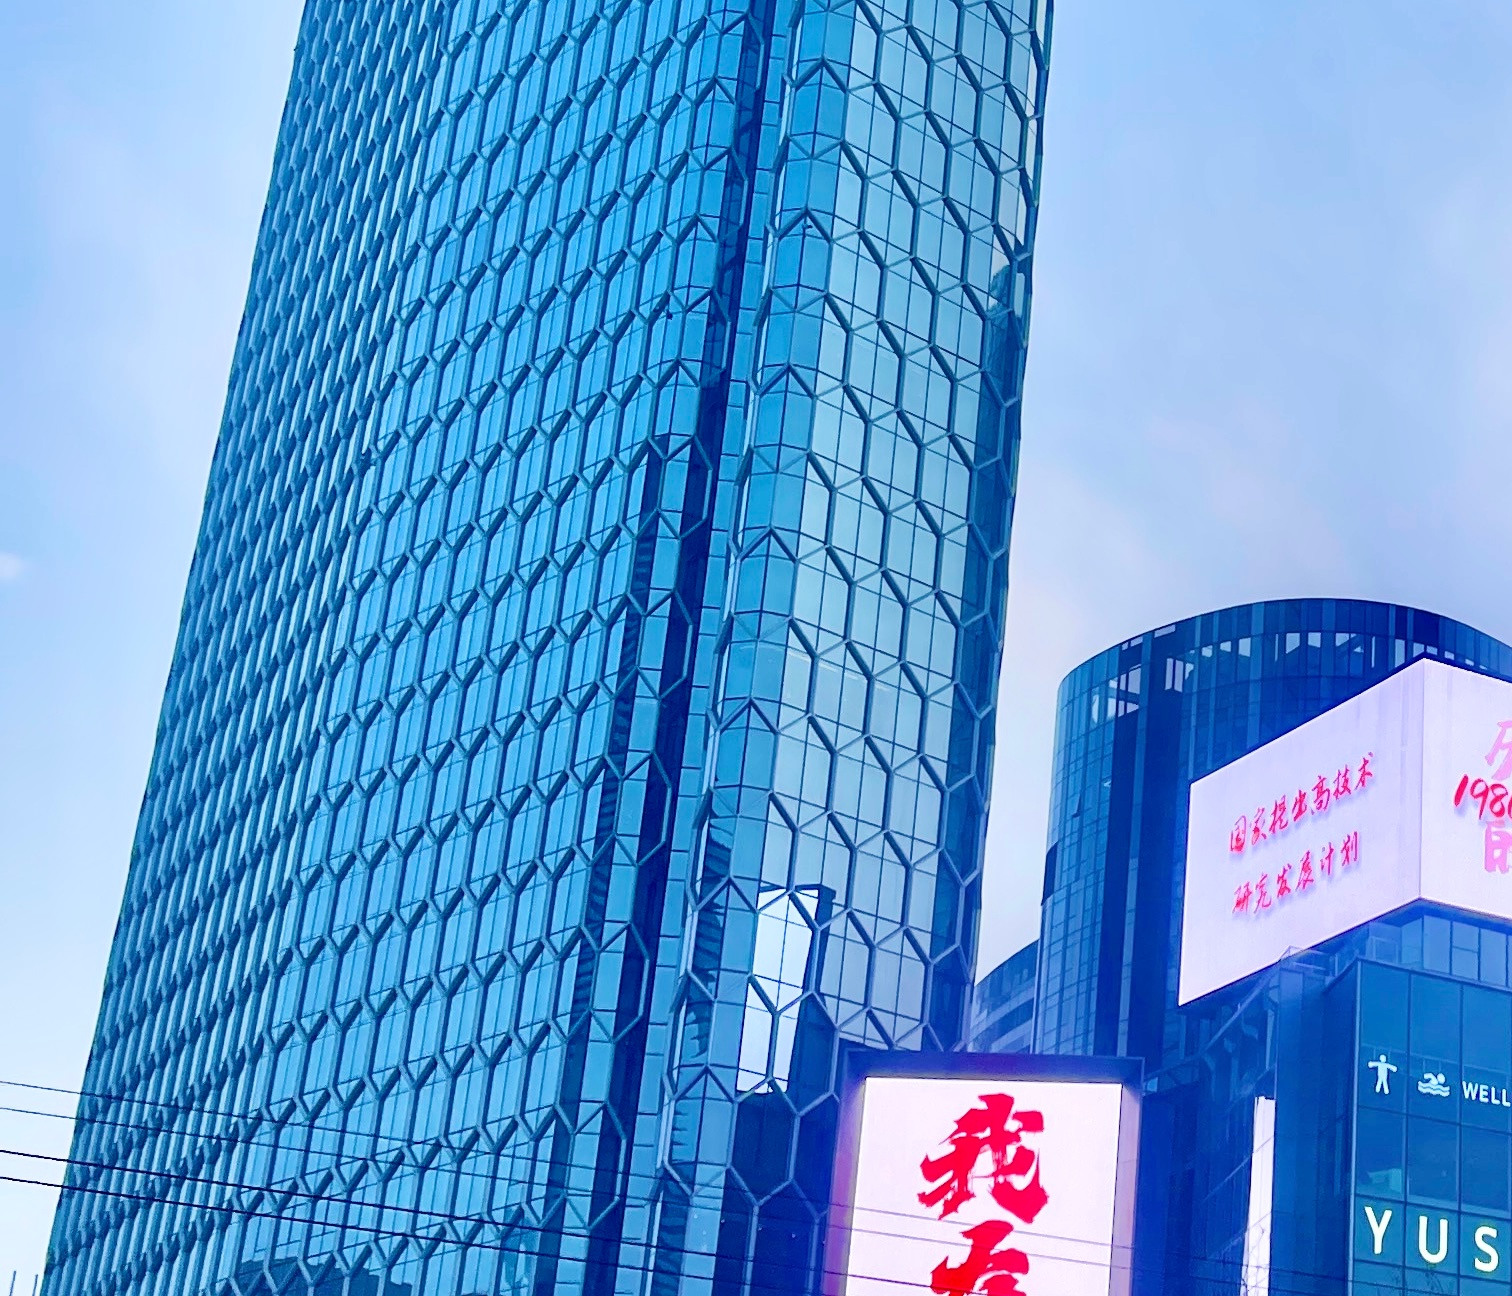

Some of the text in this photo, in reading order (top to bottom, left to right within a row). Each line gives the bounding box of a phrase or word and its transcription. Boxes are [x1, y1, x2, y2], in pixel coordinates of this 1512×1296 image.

[1230, 751, 1375, 852] 国家提出高技术
[1231, 830, 1359, 915] 研究发展计划
